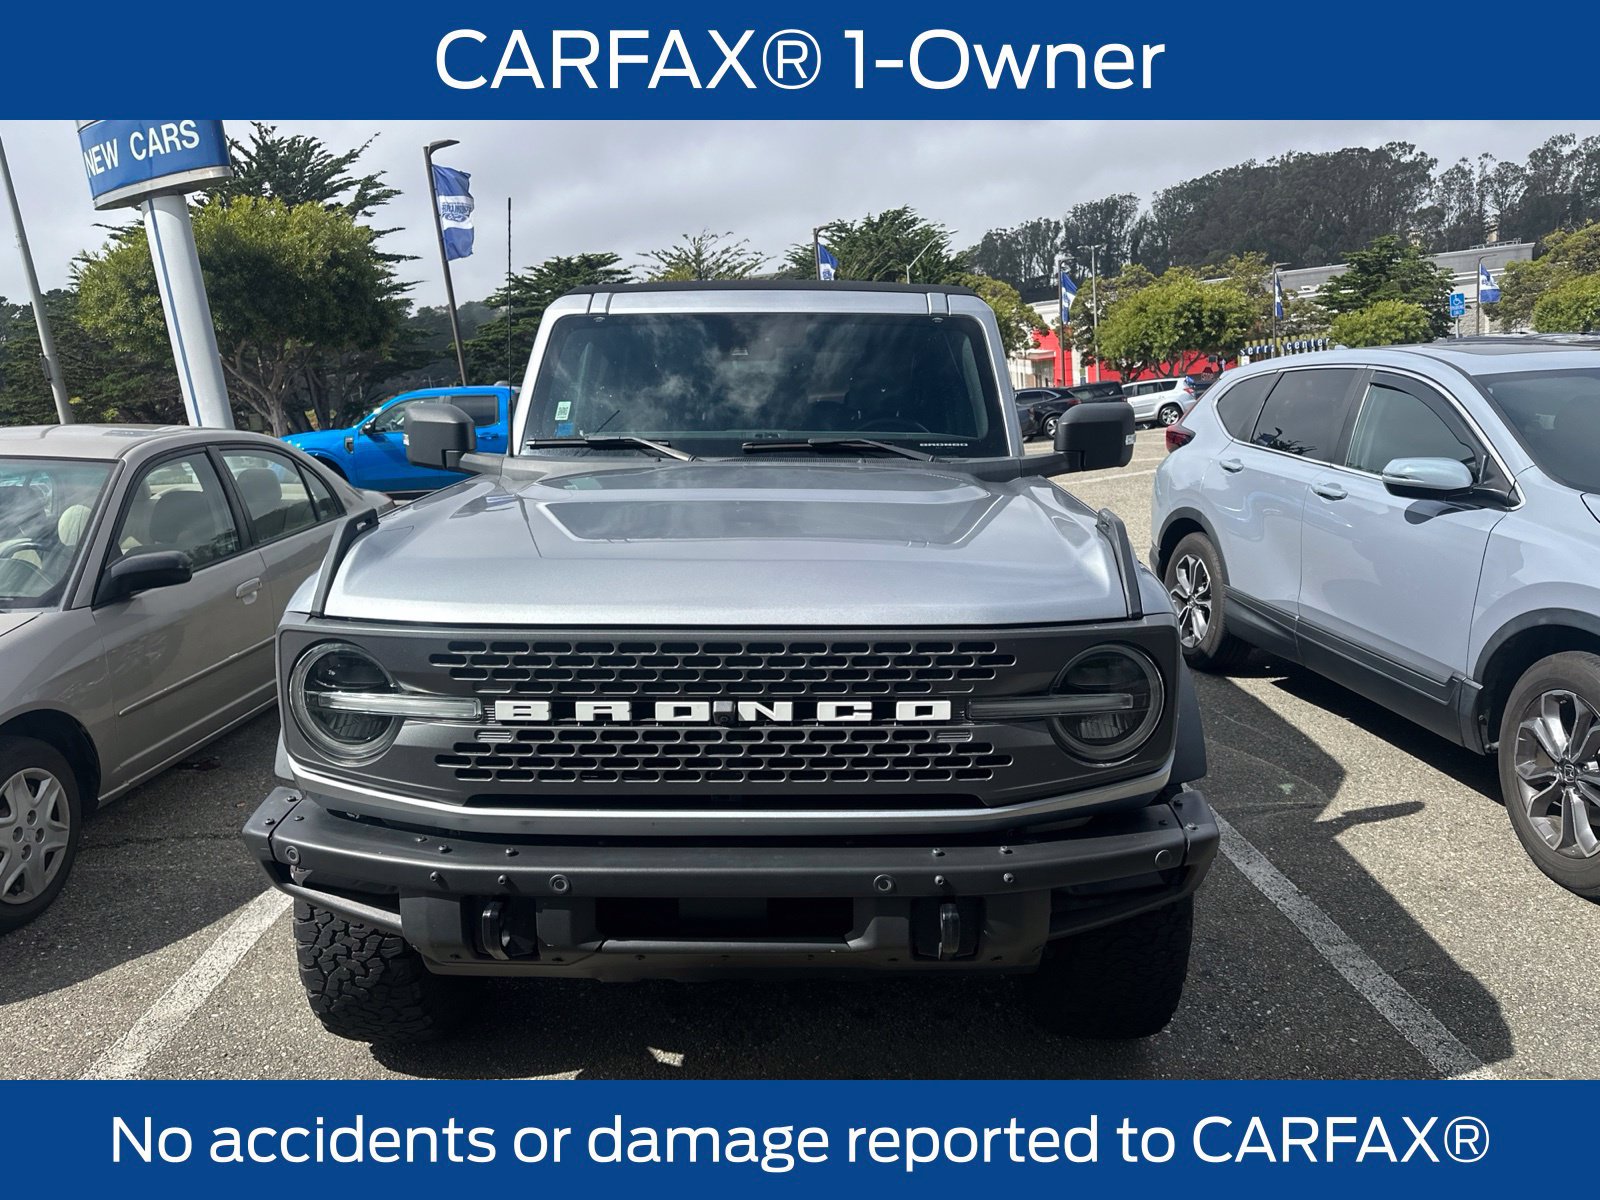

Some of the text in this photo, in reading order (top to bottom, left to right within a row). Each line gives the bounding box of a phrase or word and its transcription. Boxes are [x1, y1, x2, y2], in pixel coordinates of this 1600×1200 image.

[83, 119, 200, 178] NEW CARS
[1286, 337, 1330, 351] center
[494, 700, 952, 722] BRONCO
